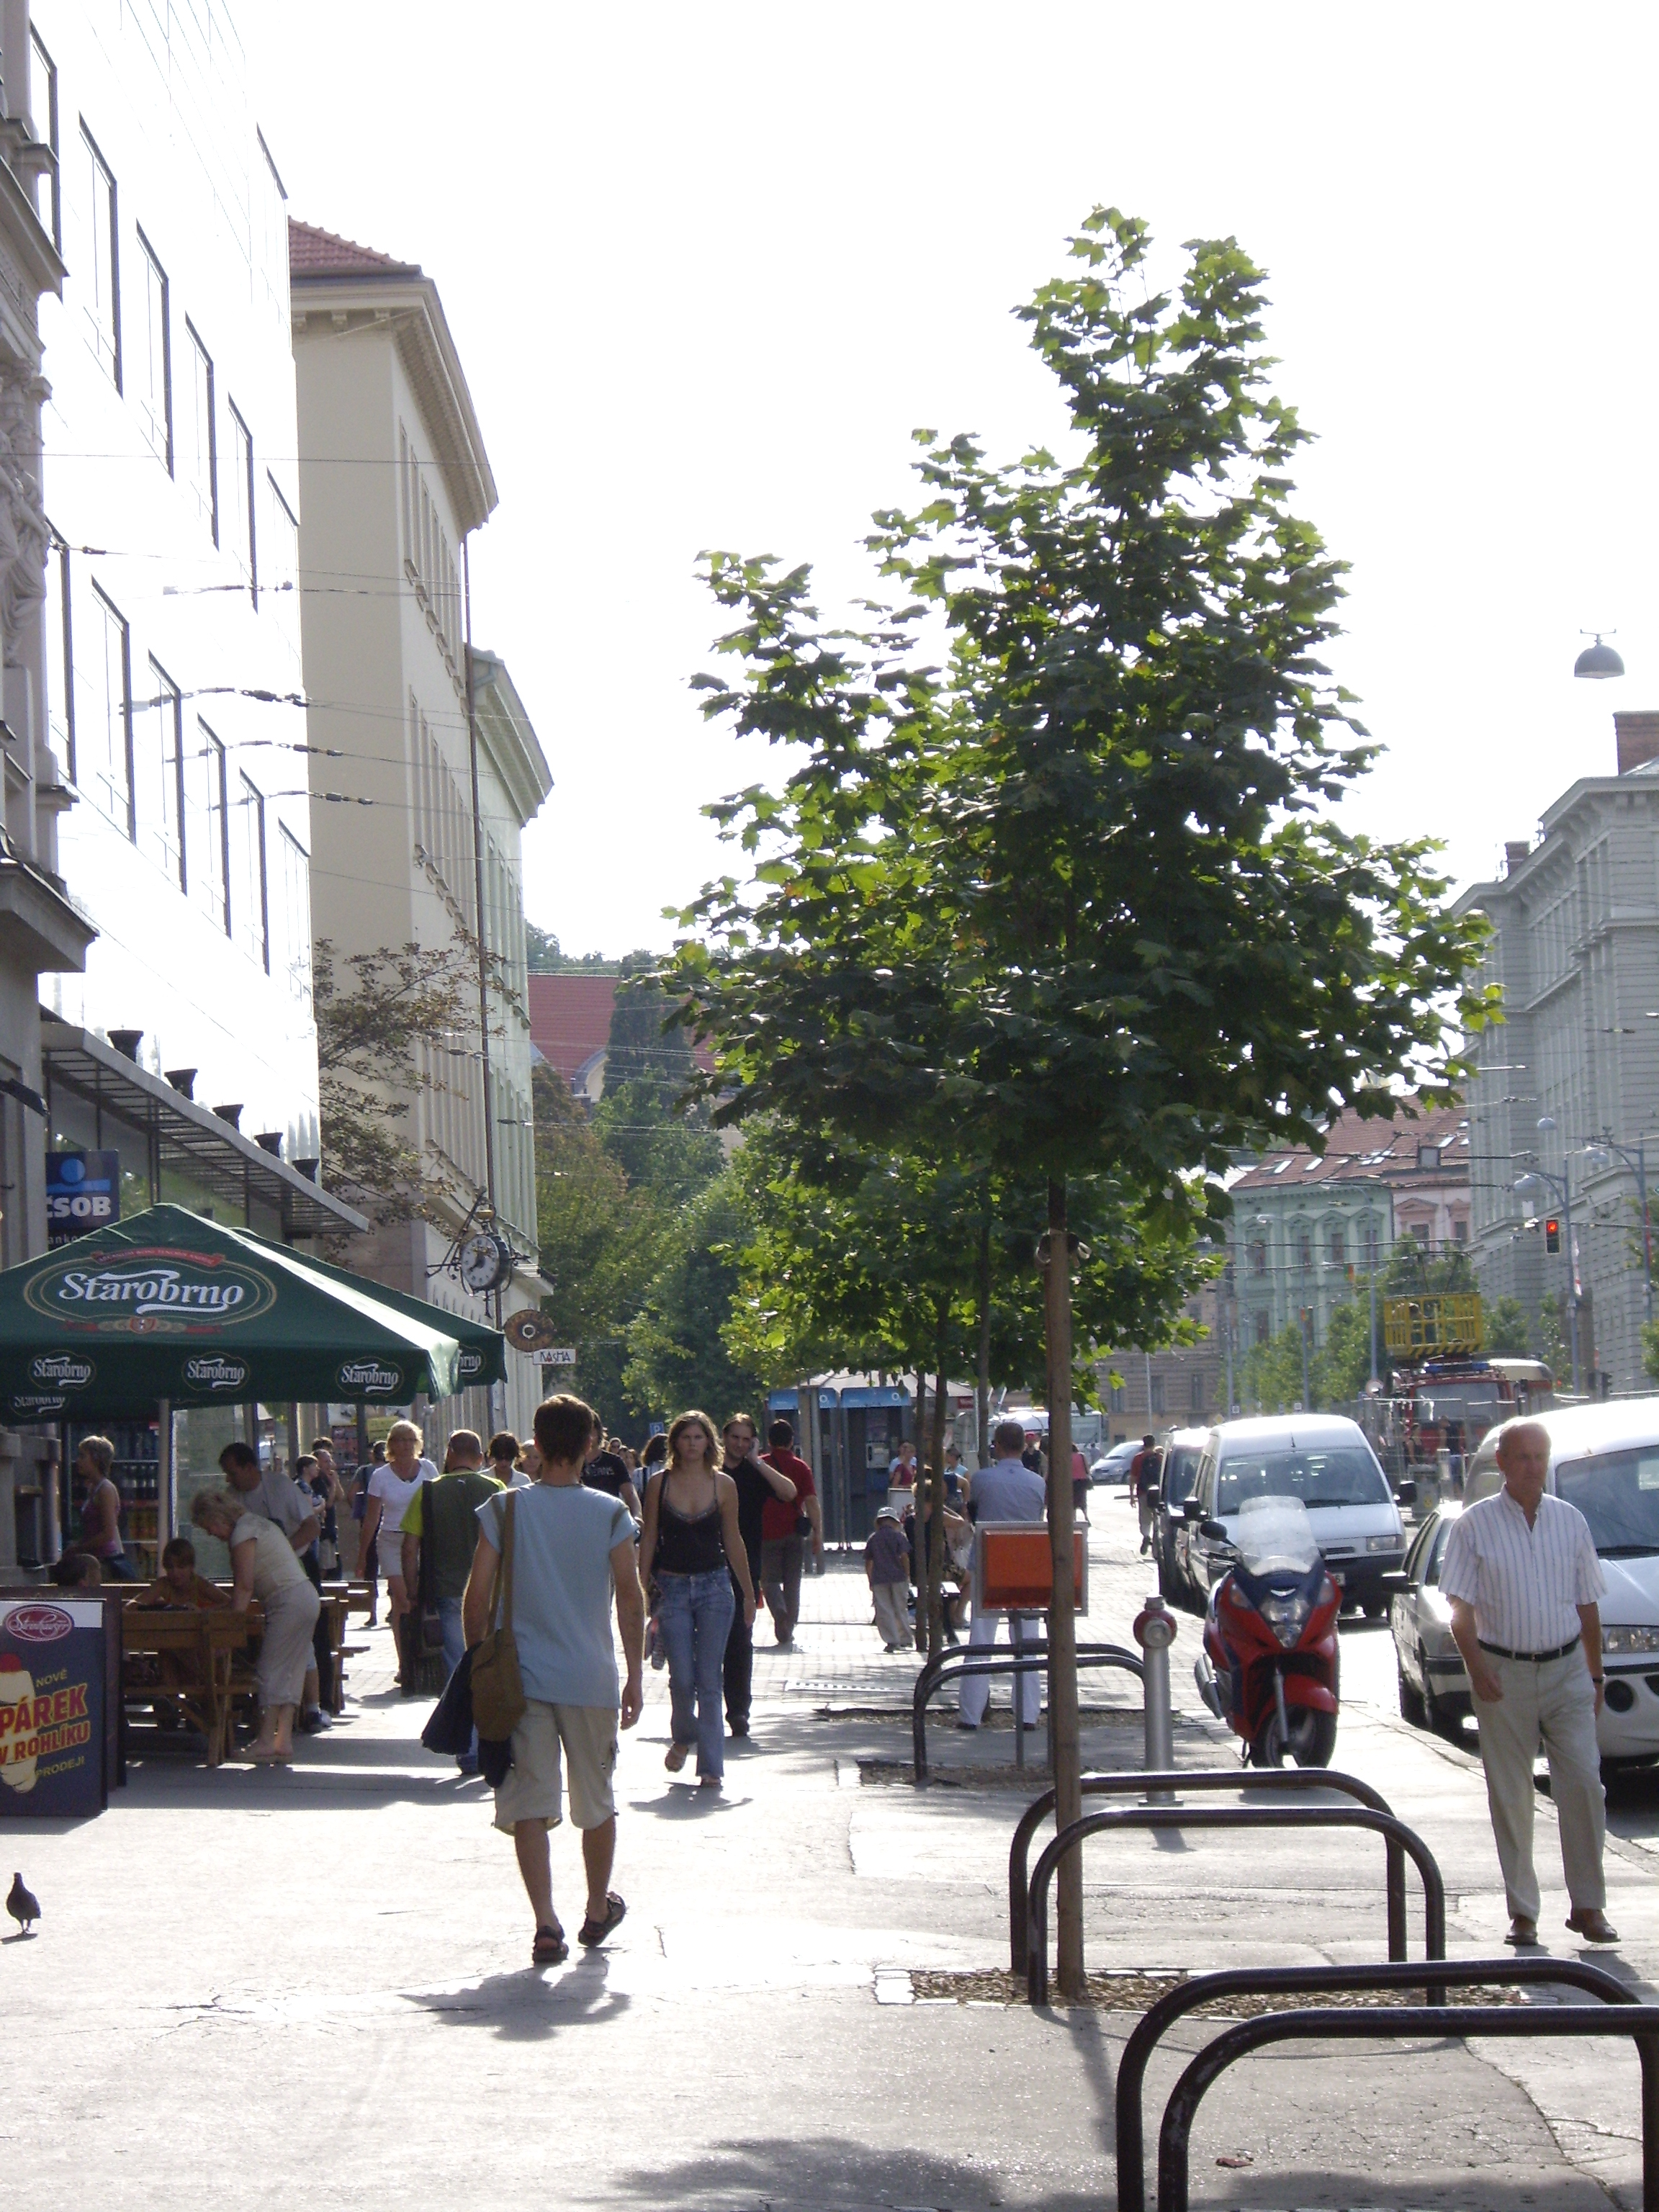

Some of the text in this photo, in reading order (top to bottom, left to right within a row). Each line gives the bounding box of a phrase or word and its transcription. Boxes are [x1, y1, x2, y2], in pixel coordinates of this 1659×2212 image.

[59, 1269, 244, 1314] Starobrno
[34, 1357, 91, 1386] Starobrno
[540, 1351, 571, 1362] KASHA
[187, 1358, 245, 1388] Starobrno
[341, 1363, 399, 1393] Starobrno
[14, 1721, 91, 1761] ROHLÍKU
